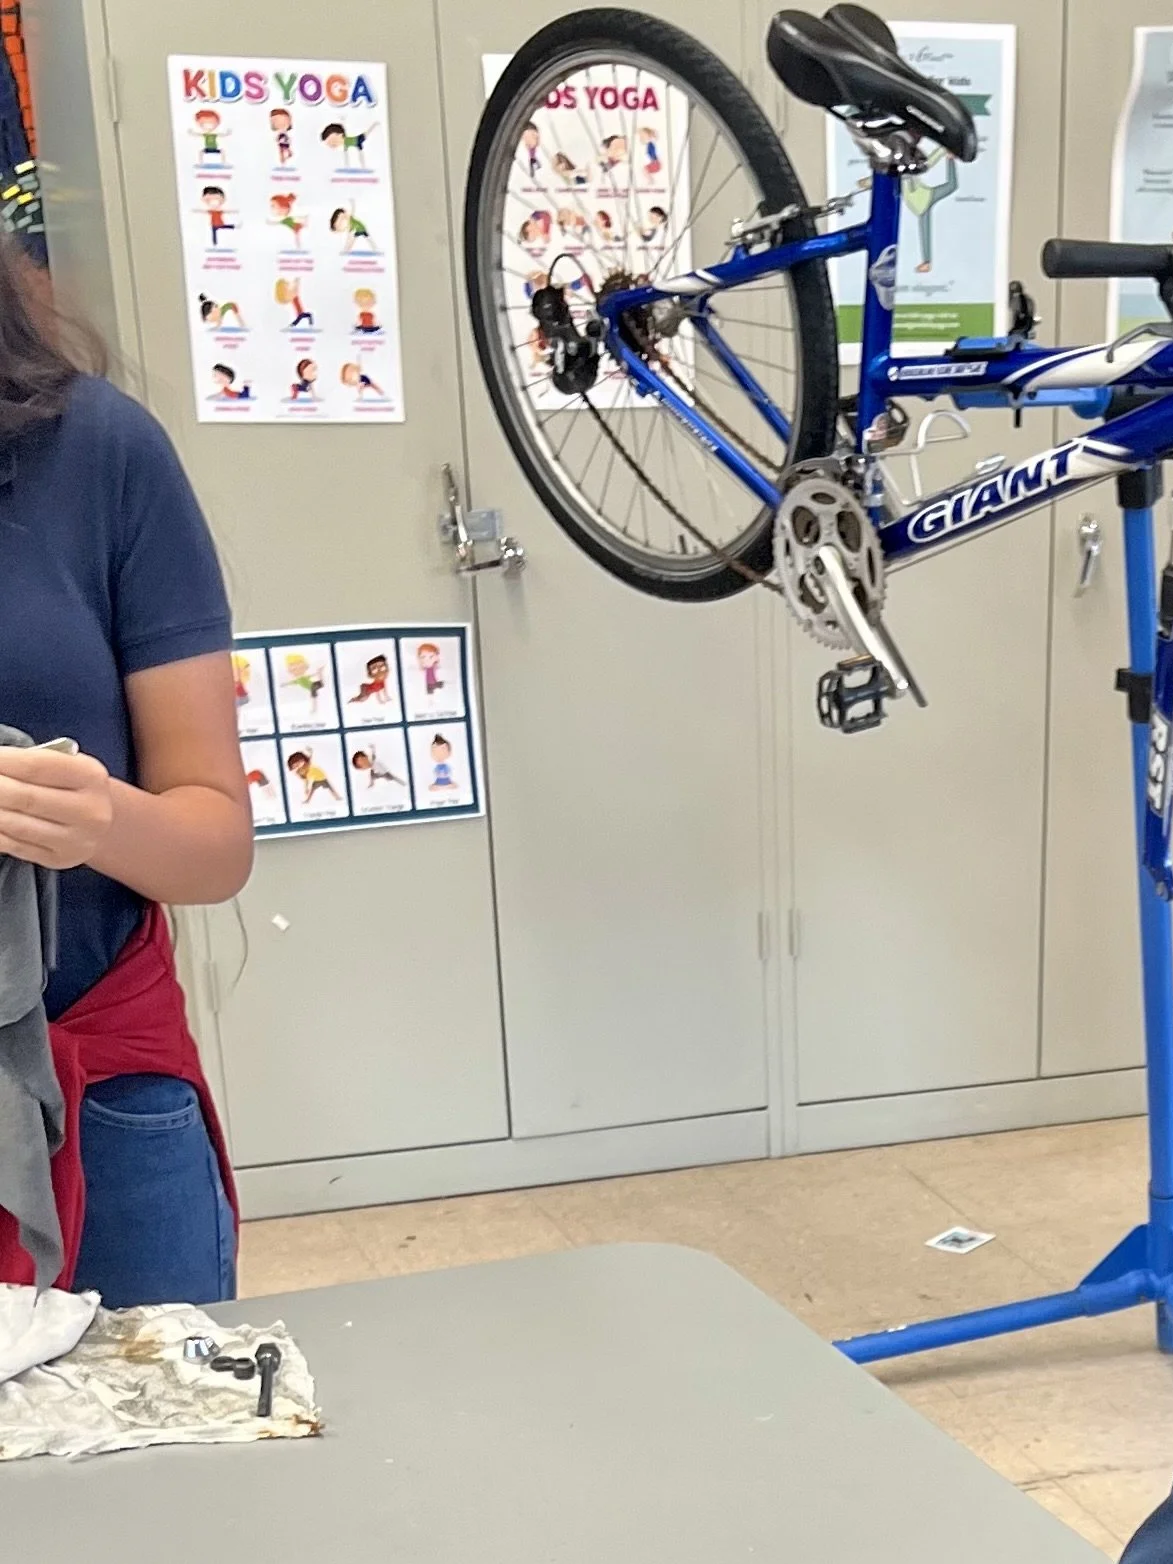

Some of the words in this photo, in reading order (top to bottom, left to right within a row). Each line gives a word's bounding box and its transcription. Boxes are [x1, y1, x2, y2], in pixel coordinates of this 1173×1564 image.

[183, 68, 267, 102] KIDS
[274, 72, 377, 107] YOGA
[545, 84, 577, 110] DS
[584, 85, 660, 112] YOGA
[907, 440, 1086, 544] GIANT
[1148, 713, 1169, 811] RST
